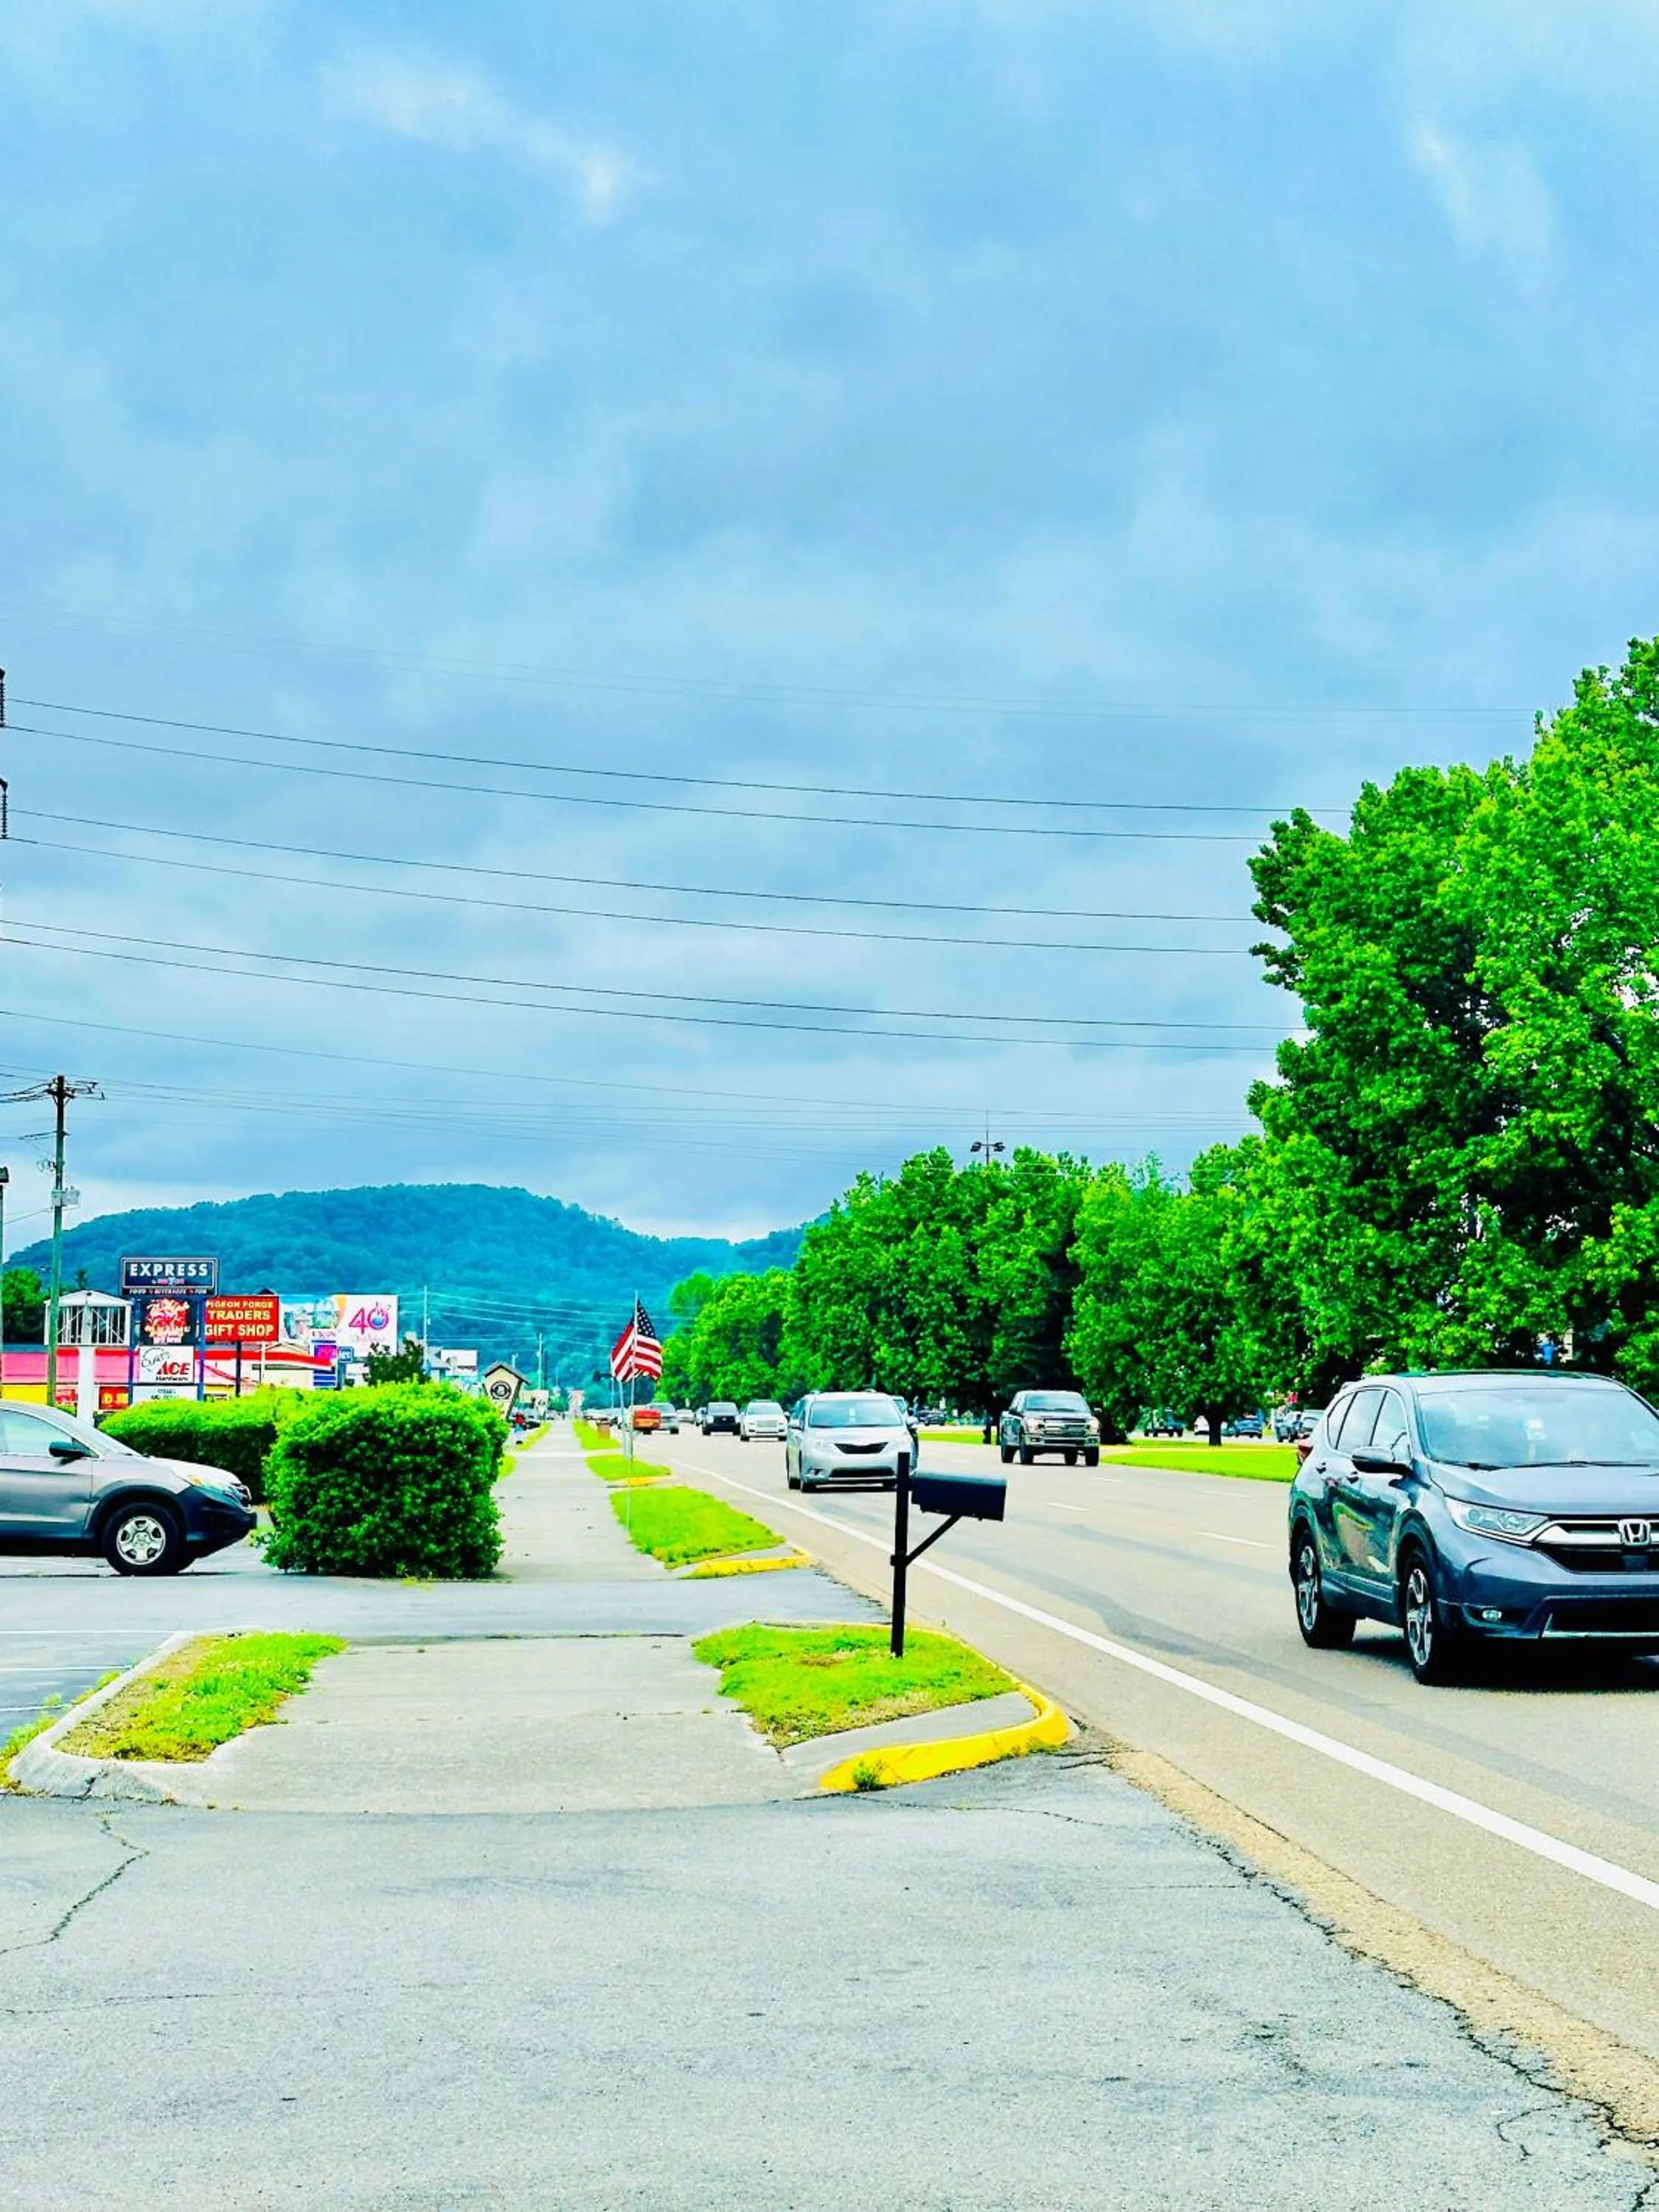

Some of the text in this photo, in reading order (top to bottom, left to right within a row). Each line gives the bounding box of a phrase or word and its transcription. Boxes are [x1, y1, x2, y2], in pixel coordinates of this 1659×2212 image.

[130, 1263, 208, 1276] EXPRESS
[243, 1301, 273, 1309] FORGE
[208, 1310, 271, 1321] TRADERS
[204, 1324, 274, 1336] GIFT SHOP
[156, 1361, 191, 1375] ACE
